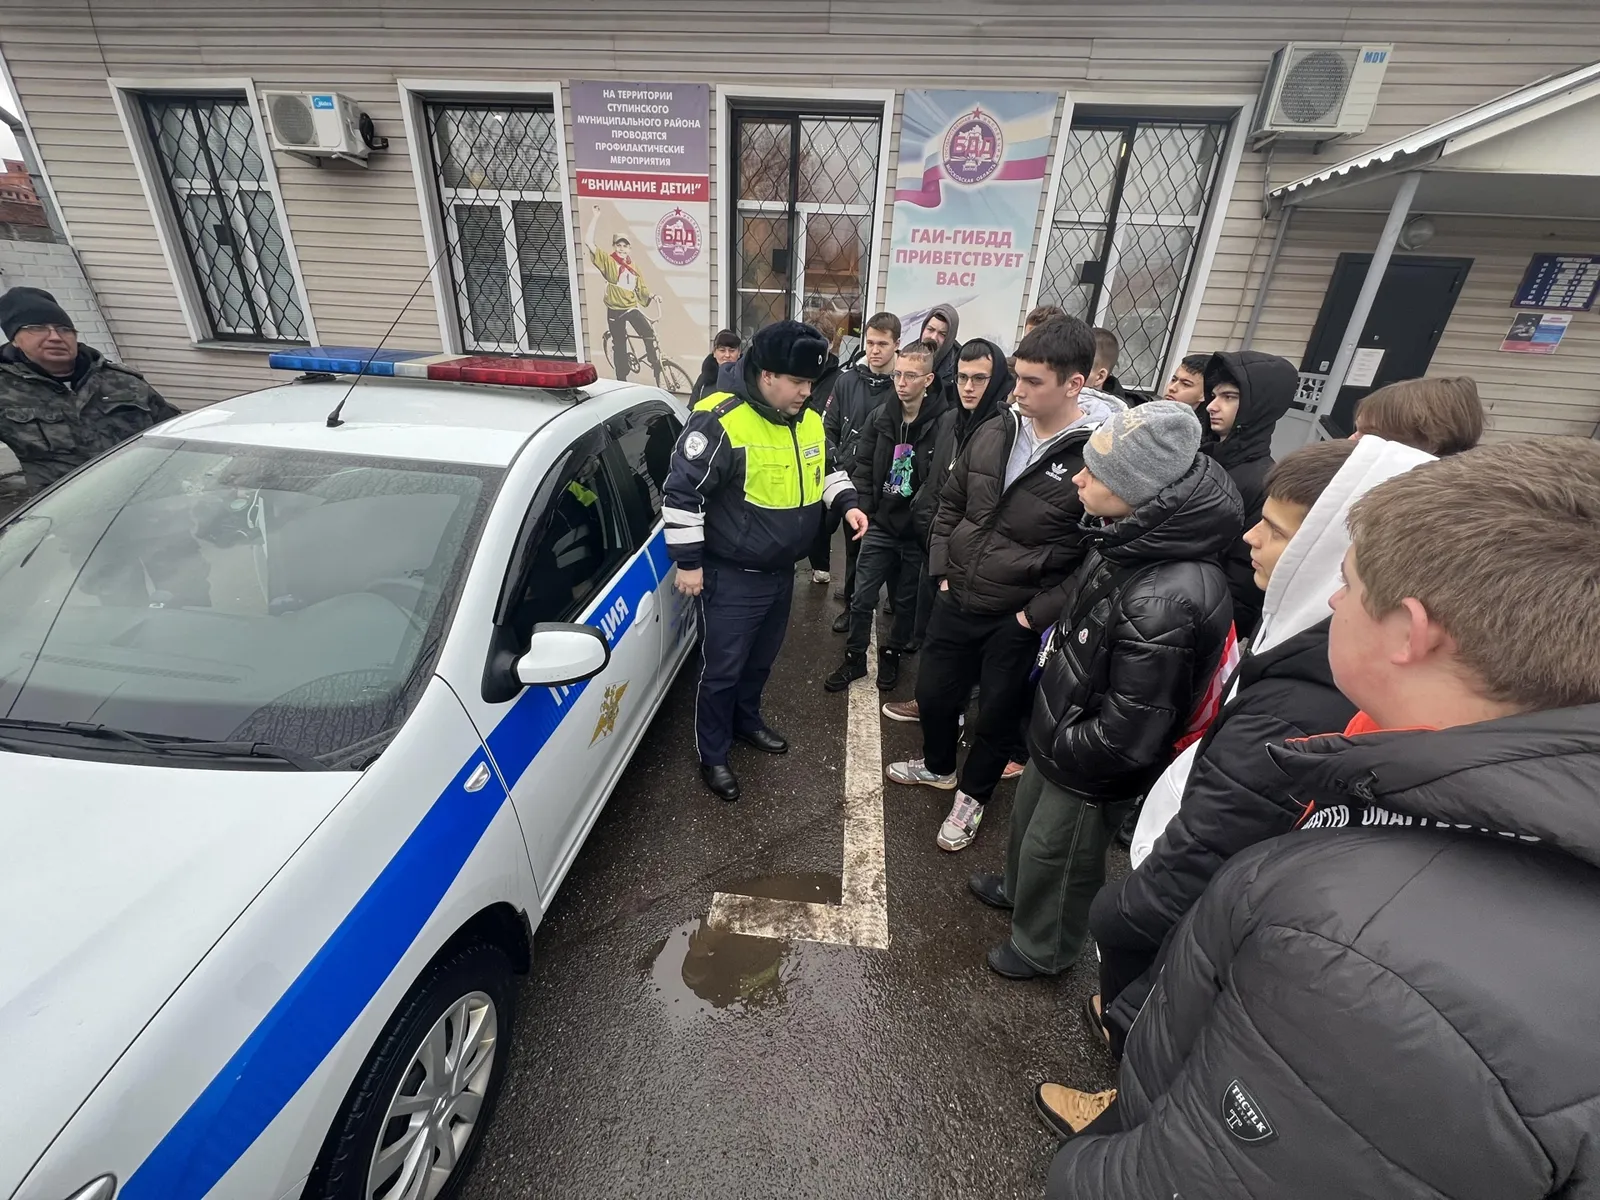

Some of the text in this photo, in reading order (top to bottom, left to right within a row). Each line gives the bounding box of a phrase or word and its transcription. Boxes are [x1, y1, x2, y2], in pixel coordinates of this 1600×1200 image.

[1363, 51, 1387, 63] MDV
[602, 89, 673, 100] НА ТЕРРИТОРИИ
[607, 103, 669, 114] СТУПИНСКОГО
[577, 115, 701, 128] МУНИЦИПАЛЬНОГО РАЙОНА
[611, 130, 667, 141] ПРОВОДЯТСЯ
[595, 142, 685, 154] ПРОФИЛАКТИЧЕСКИЕ
[954, 136, 995, 158] БДД
[610, 155, 671, 166] МЕРОПРИЯТИЯ
[945, 163, 997, 183] МОСКОВСКАЯ ОБЛАСТЬ
[581, 178, 657, 193] “ВНИМАНИЕ
[663, 229, 696, 247] БДД
[911, 228, 1012, 249] ГАИ-ГИБДД
[895, 249, 1024, 268] ПРИВЕТСТВУЕТ
[936, 271, 976, 287] ВАС!
[1045, 470, 1062, 481] adidas
